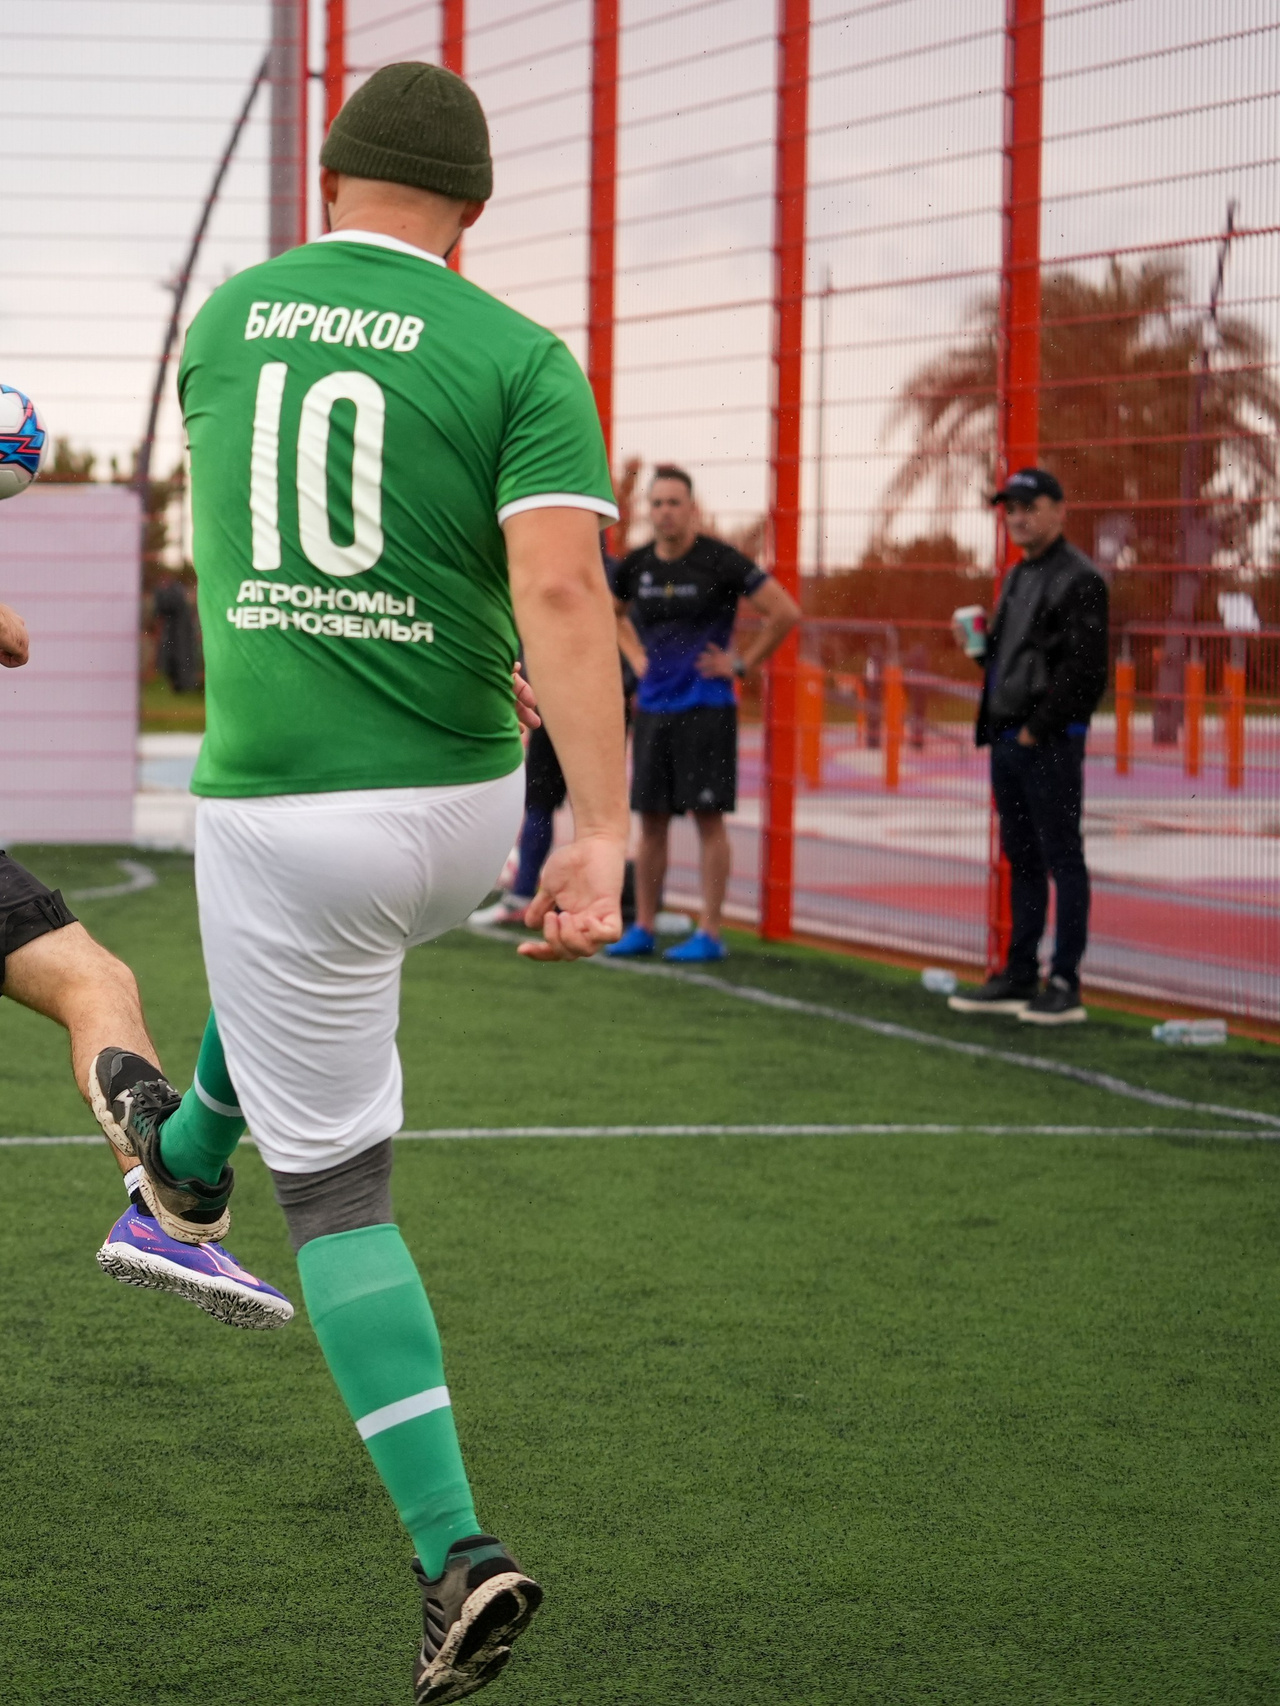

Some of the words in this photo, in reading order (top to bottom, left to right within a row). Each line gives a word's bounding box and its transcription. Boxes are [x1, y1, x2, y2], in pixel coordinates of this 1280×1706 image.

[244, 301, 425, 352] БИРЮКОВ
[249, 361, 386, 577] 10
[236, 579, 416, 617] АГРОНОМЫ
[226, 606, 435, 643] ЧЕРНОЗЕМЬЯ
